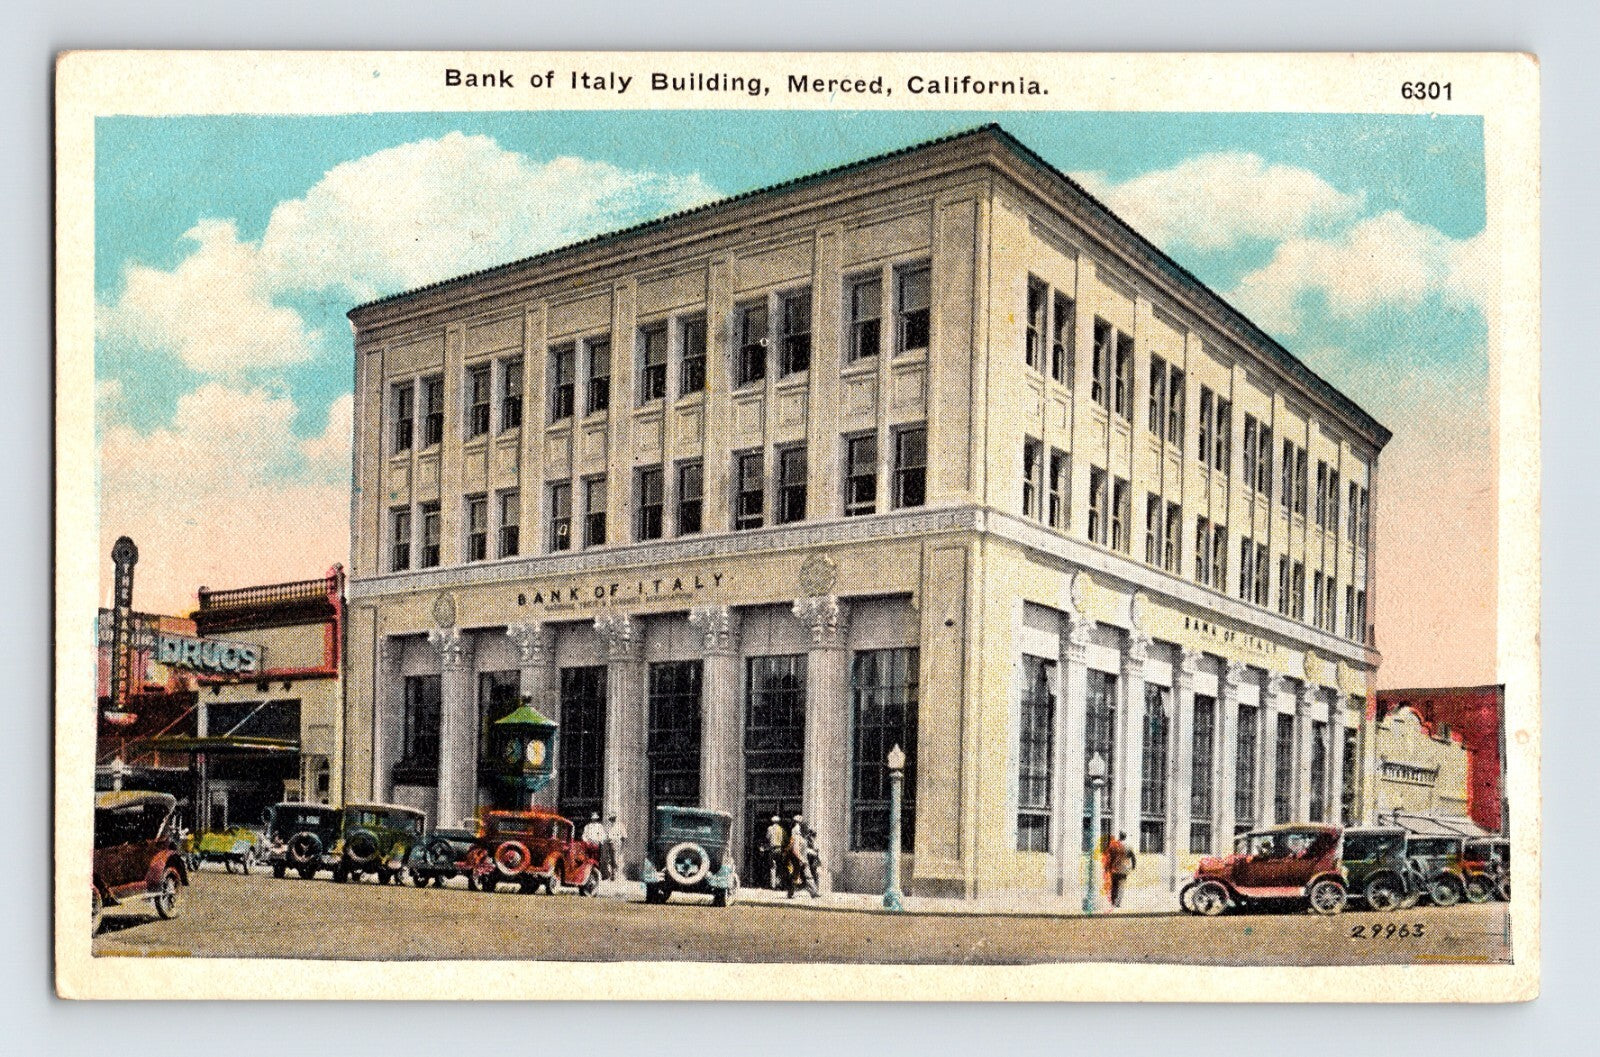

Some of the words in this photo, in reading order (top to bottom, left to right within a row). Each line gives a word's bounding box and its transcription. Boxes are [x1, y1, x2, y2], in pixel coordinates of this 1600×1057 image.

[446, 69, 513, 87] Bank
[530, 70, 555, 88] of
[571, 71, 633, 93] Italy
[652, 73, 769, 96] Building,
[788, 75, 892, 97] Merced,
[908, 76, 1048, 95] California.
[1401, 81, 1451, 100] 6301
[517, 587, 579, 606] BANK
[594, 583, 619, 599] OF
[638, 573, 724, 595] ITALY
[157, 636, 257, 671] DRUGS
[1351, 923, 1425, 939] 29963
